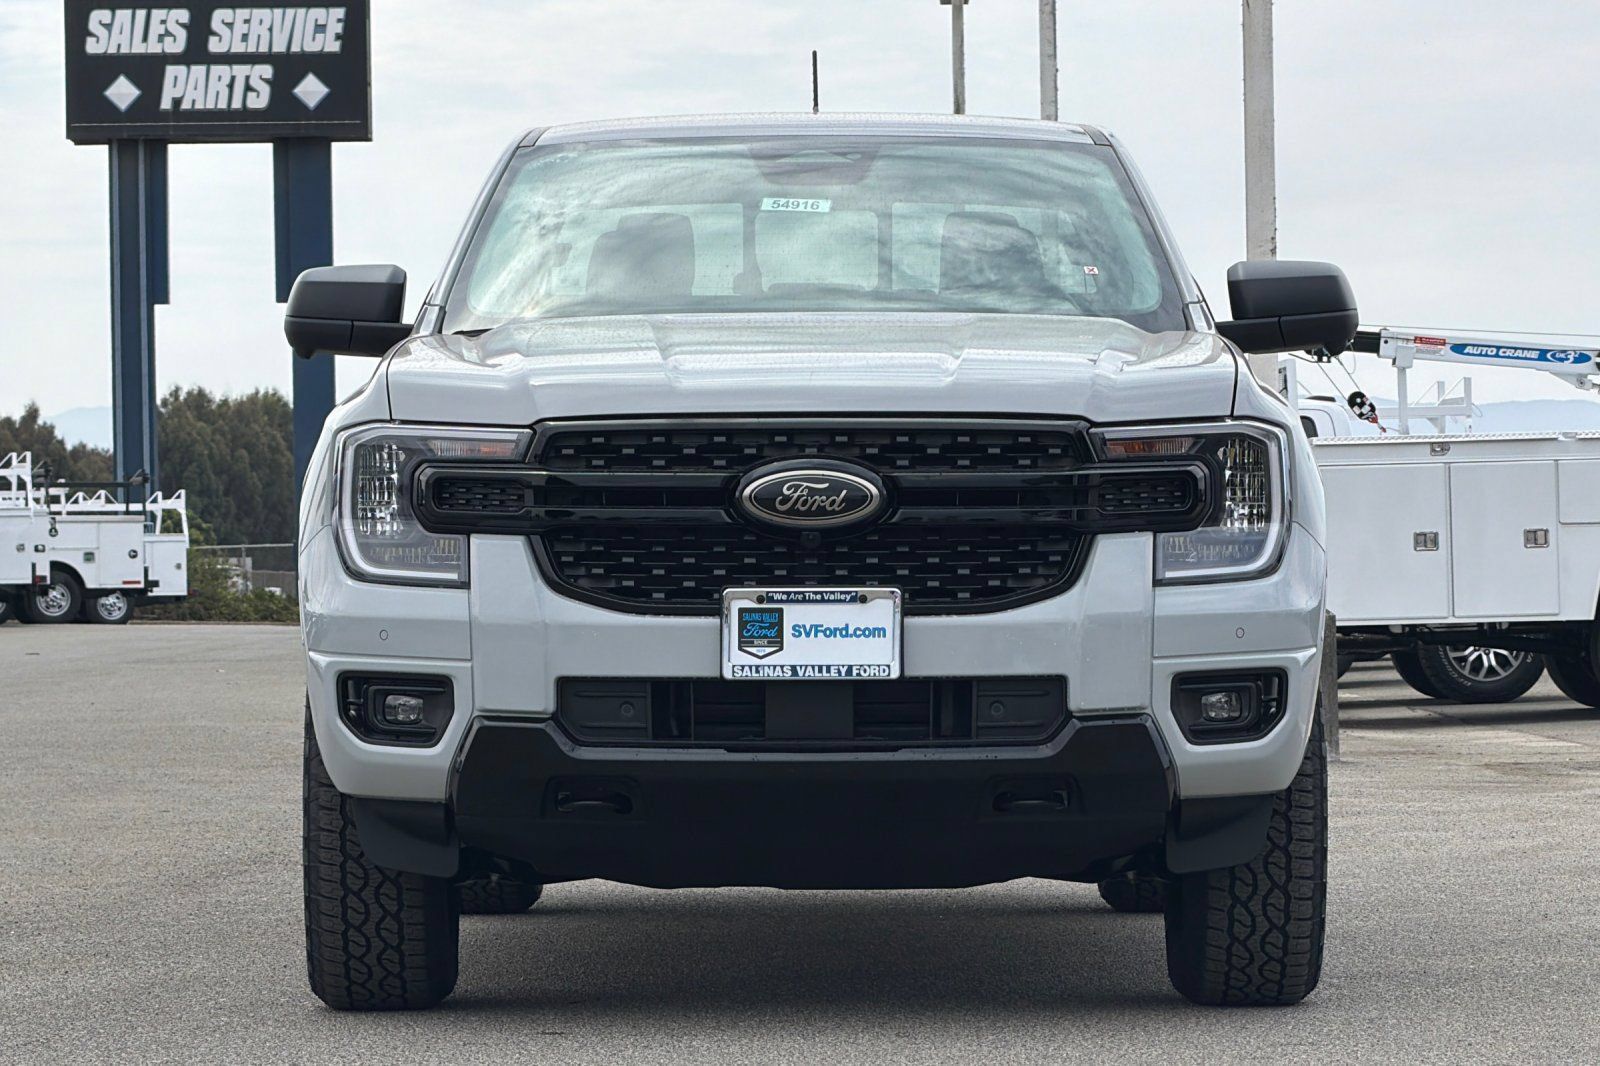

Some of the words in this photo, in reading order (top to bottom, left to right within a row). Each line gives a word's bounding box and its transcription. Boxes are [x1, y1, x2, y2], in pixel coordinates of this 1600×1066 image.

[85, 8, 191, 54] SALES
[207, 7, 346, 54] SERVICE
[160, 64, 274, 111] PARTS
[771, 199, 820, 210] 54916
[1464, 345, 1498, 356] AUTO
[1499, 348, 1540, 359] CRANE
[775, 481, 848, 512] Ford
[743, 612, 762, 621] SALINAS
[762, 612, 779, 622] VALLEY
[743, 622, 779, 637] Ford
[791, 623, 887, 639] SVFord.com
[733, 665, 792, 677] SALINAS
[794, 665, 847, 677] VALLEY
[852, 665, 890, 677] FORD
